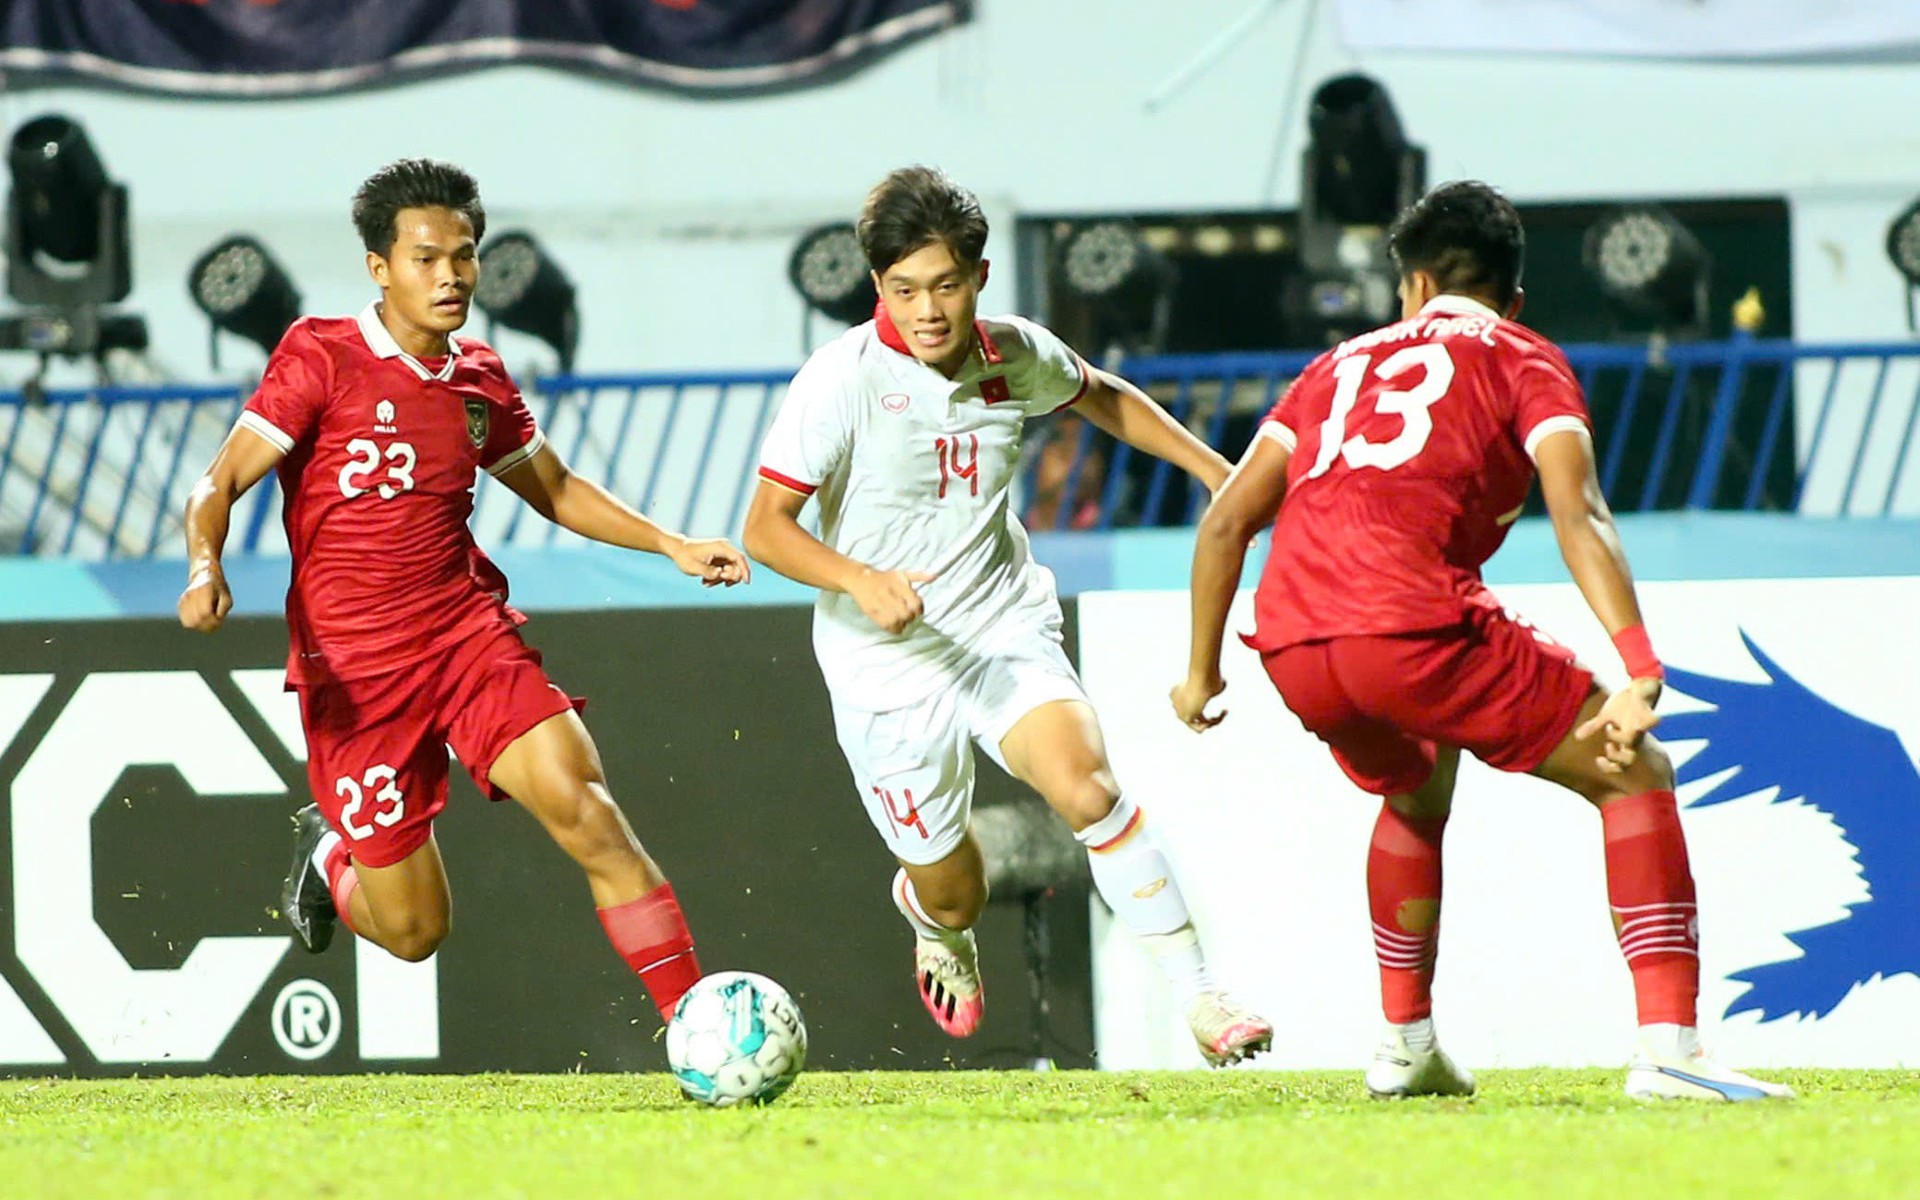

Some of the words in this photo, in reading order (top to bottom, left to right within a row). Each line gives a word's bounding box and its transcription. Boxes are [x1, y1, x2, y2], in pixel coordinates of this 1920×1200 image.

[1308, 342, 1456, 479] 13
[337, 438, 417, 499] 23
[935, 432, 979, 499] 14
[335, 763, 404, 841] 23
[871, 786, 930, 839] 14
